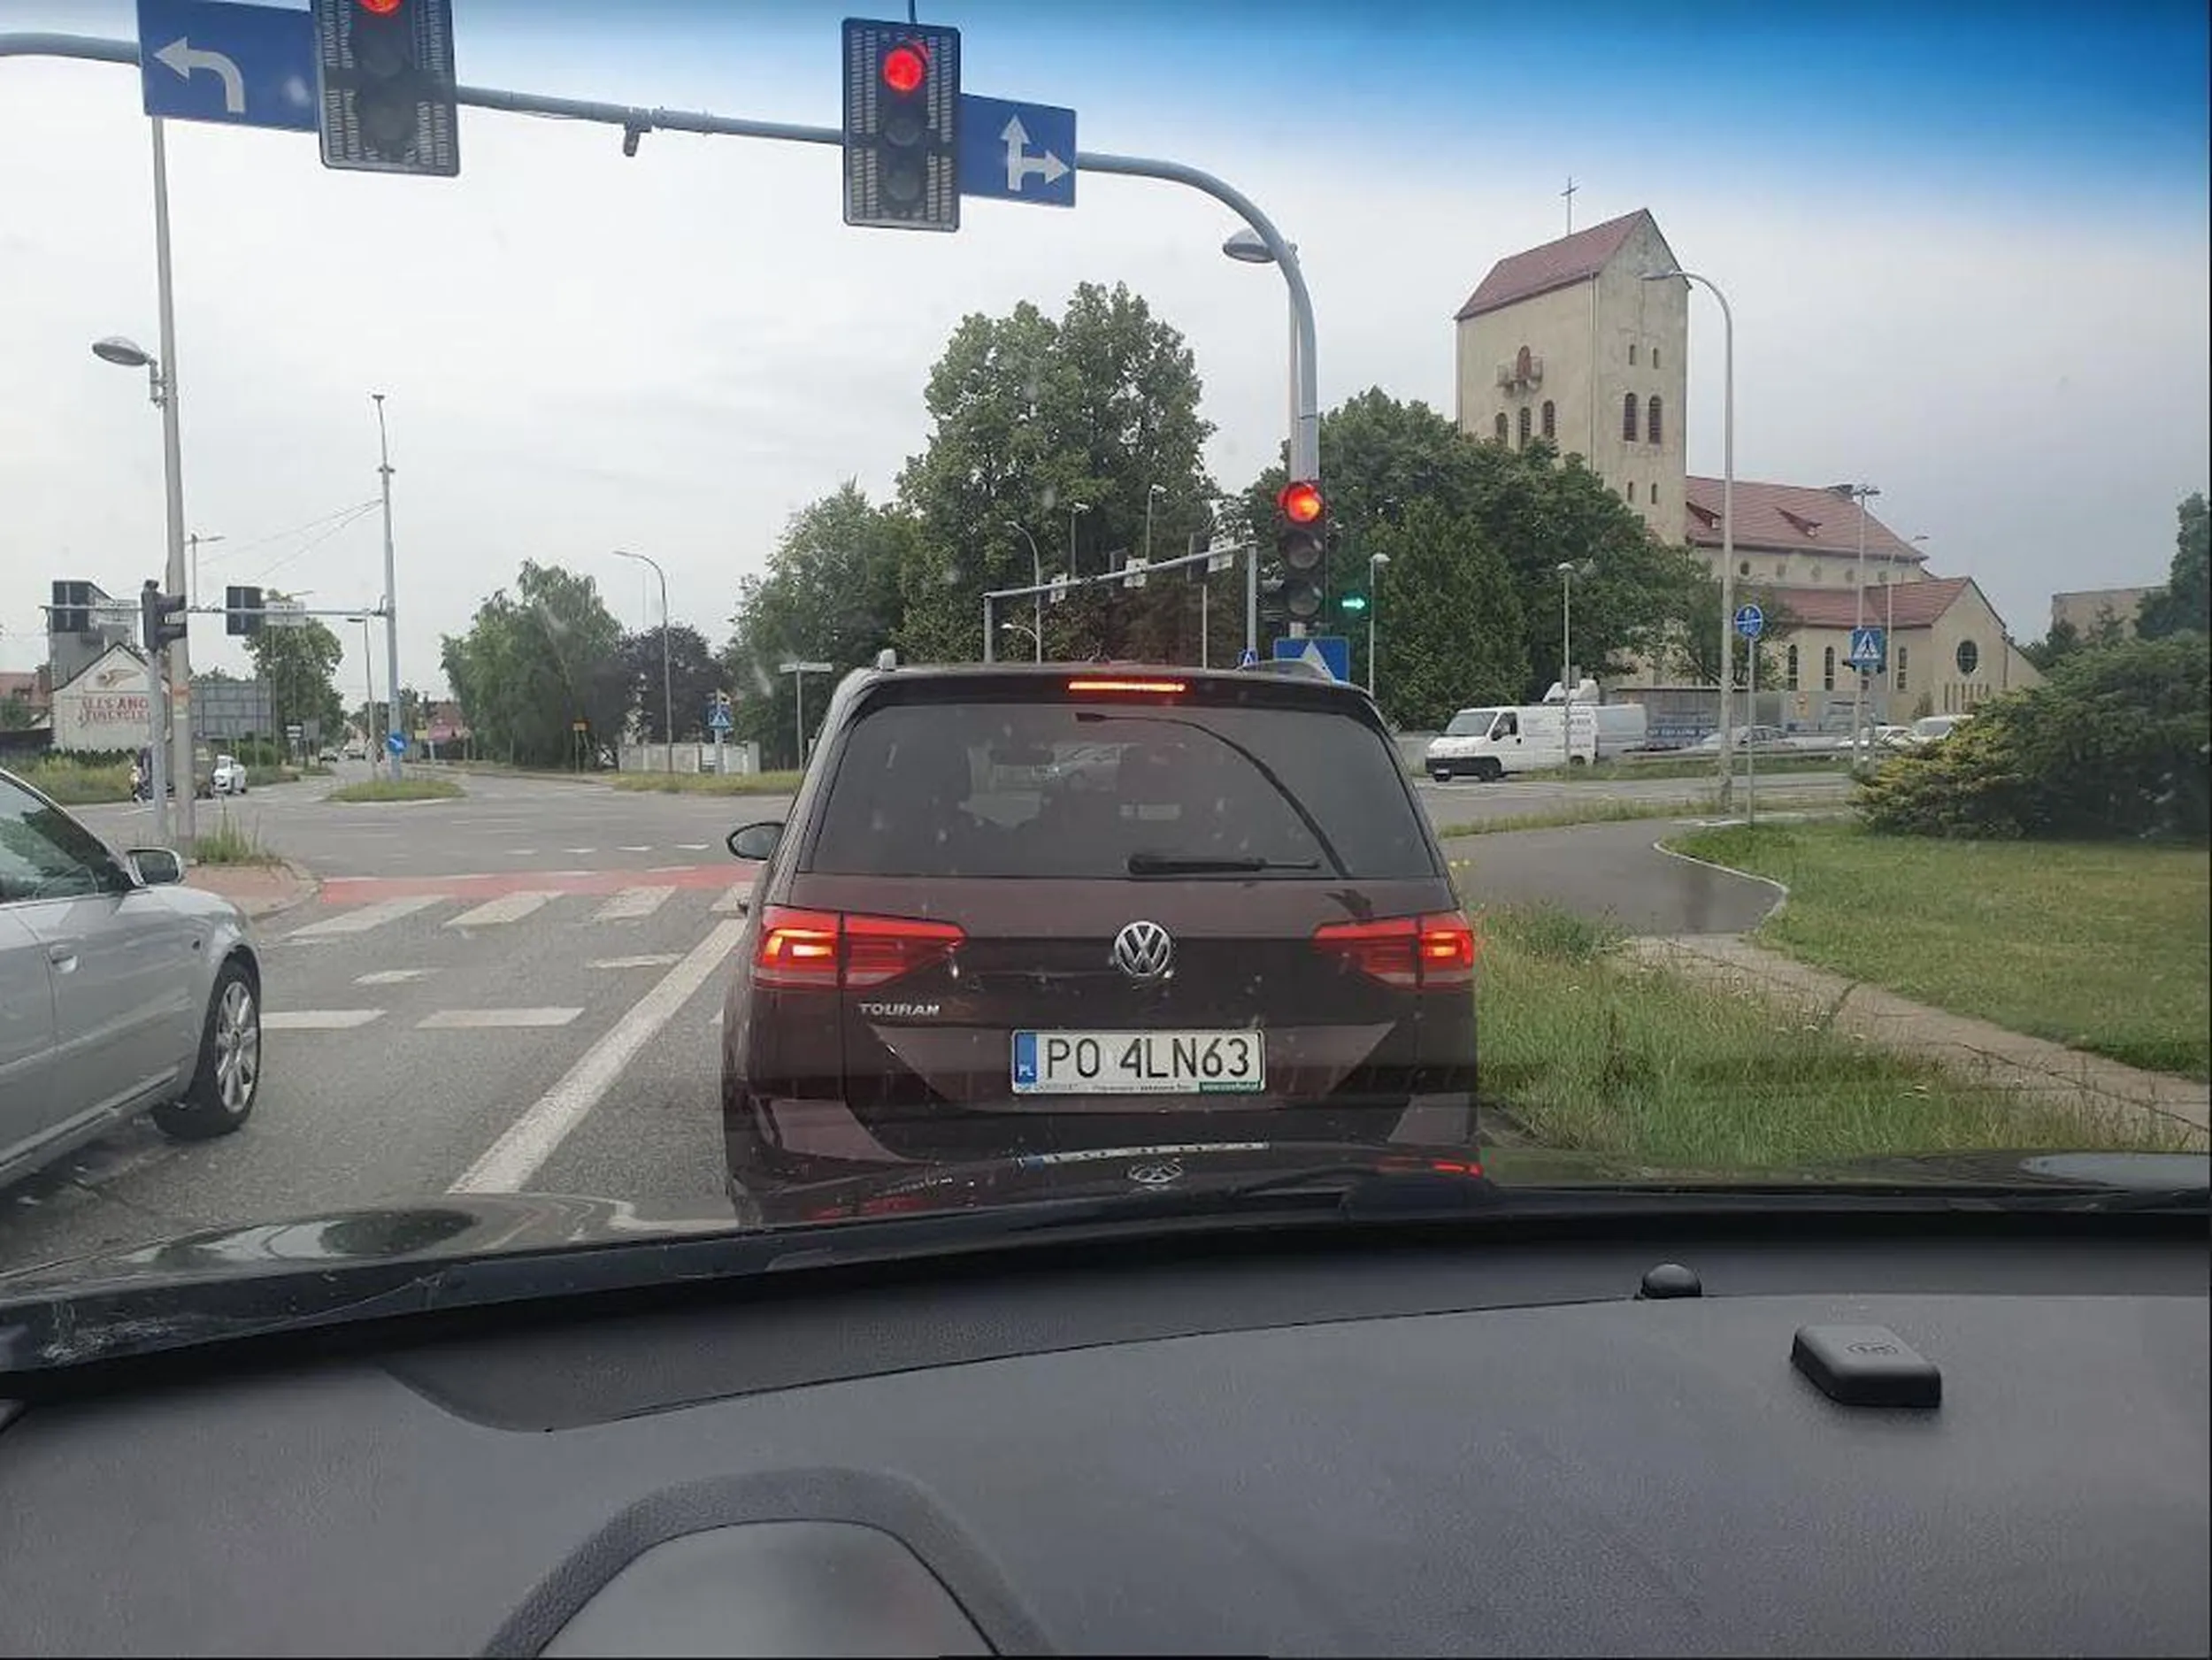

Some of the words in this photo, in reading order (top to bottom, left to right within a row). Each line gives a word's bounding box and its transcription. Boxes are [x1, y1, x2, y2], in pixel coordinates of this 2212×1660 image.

[858, 1002, 941, 1017] TOURAN
[1048, 1037, 1101, 1079] PO
[1119, 1037, 1249, 1079] 4LN63
